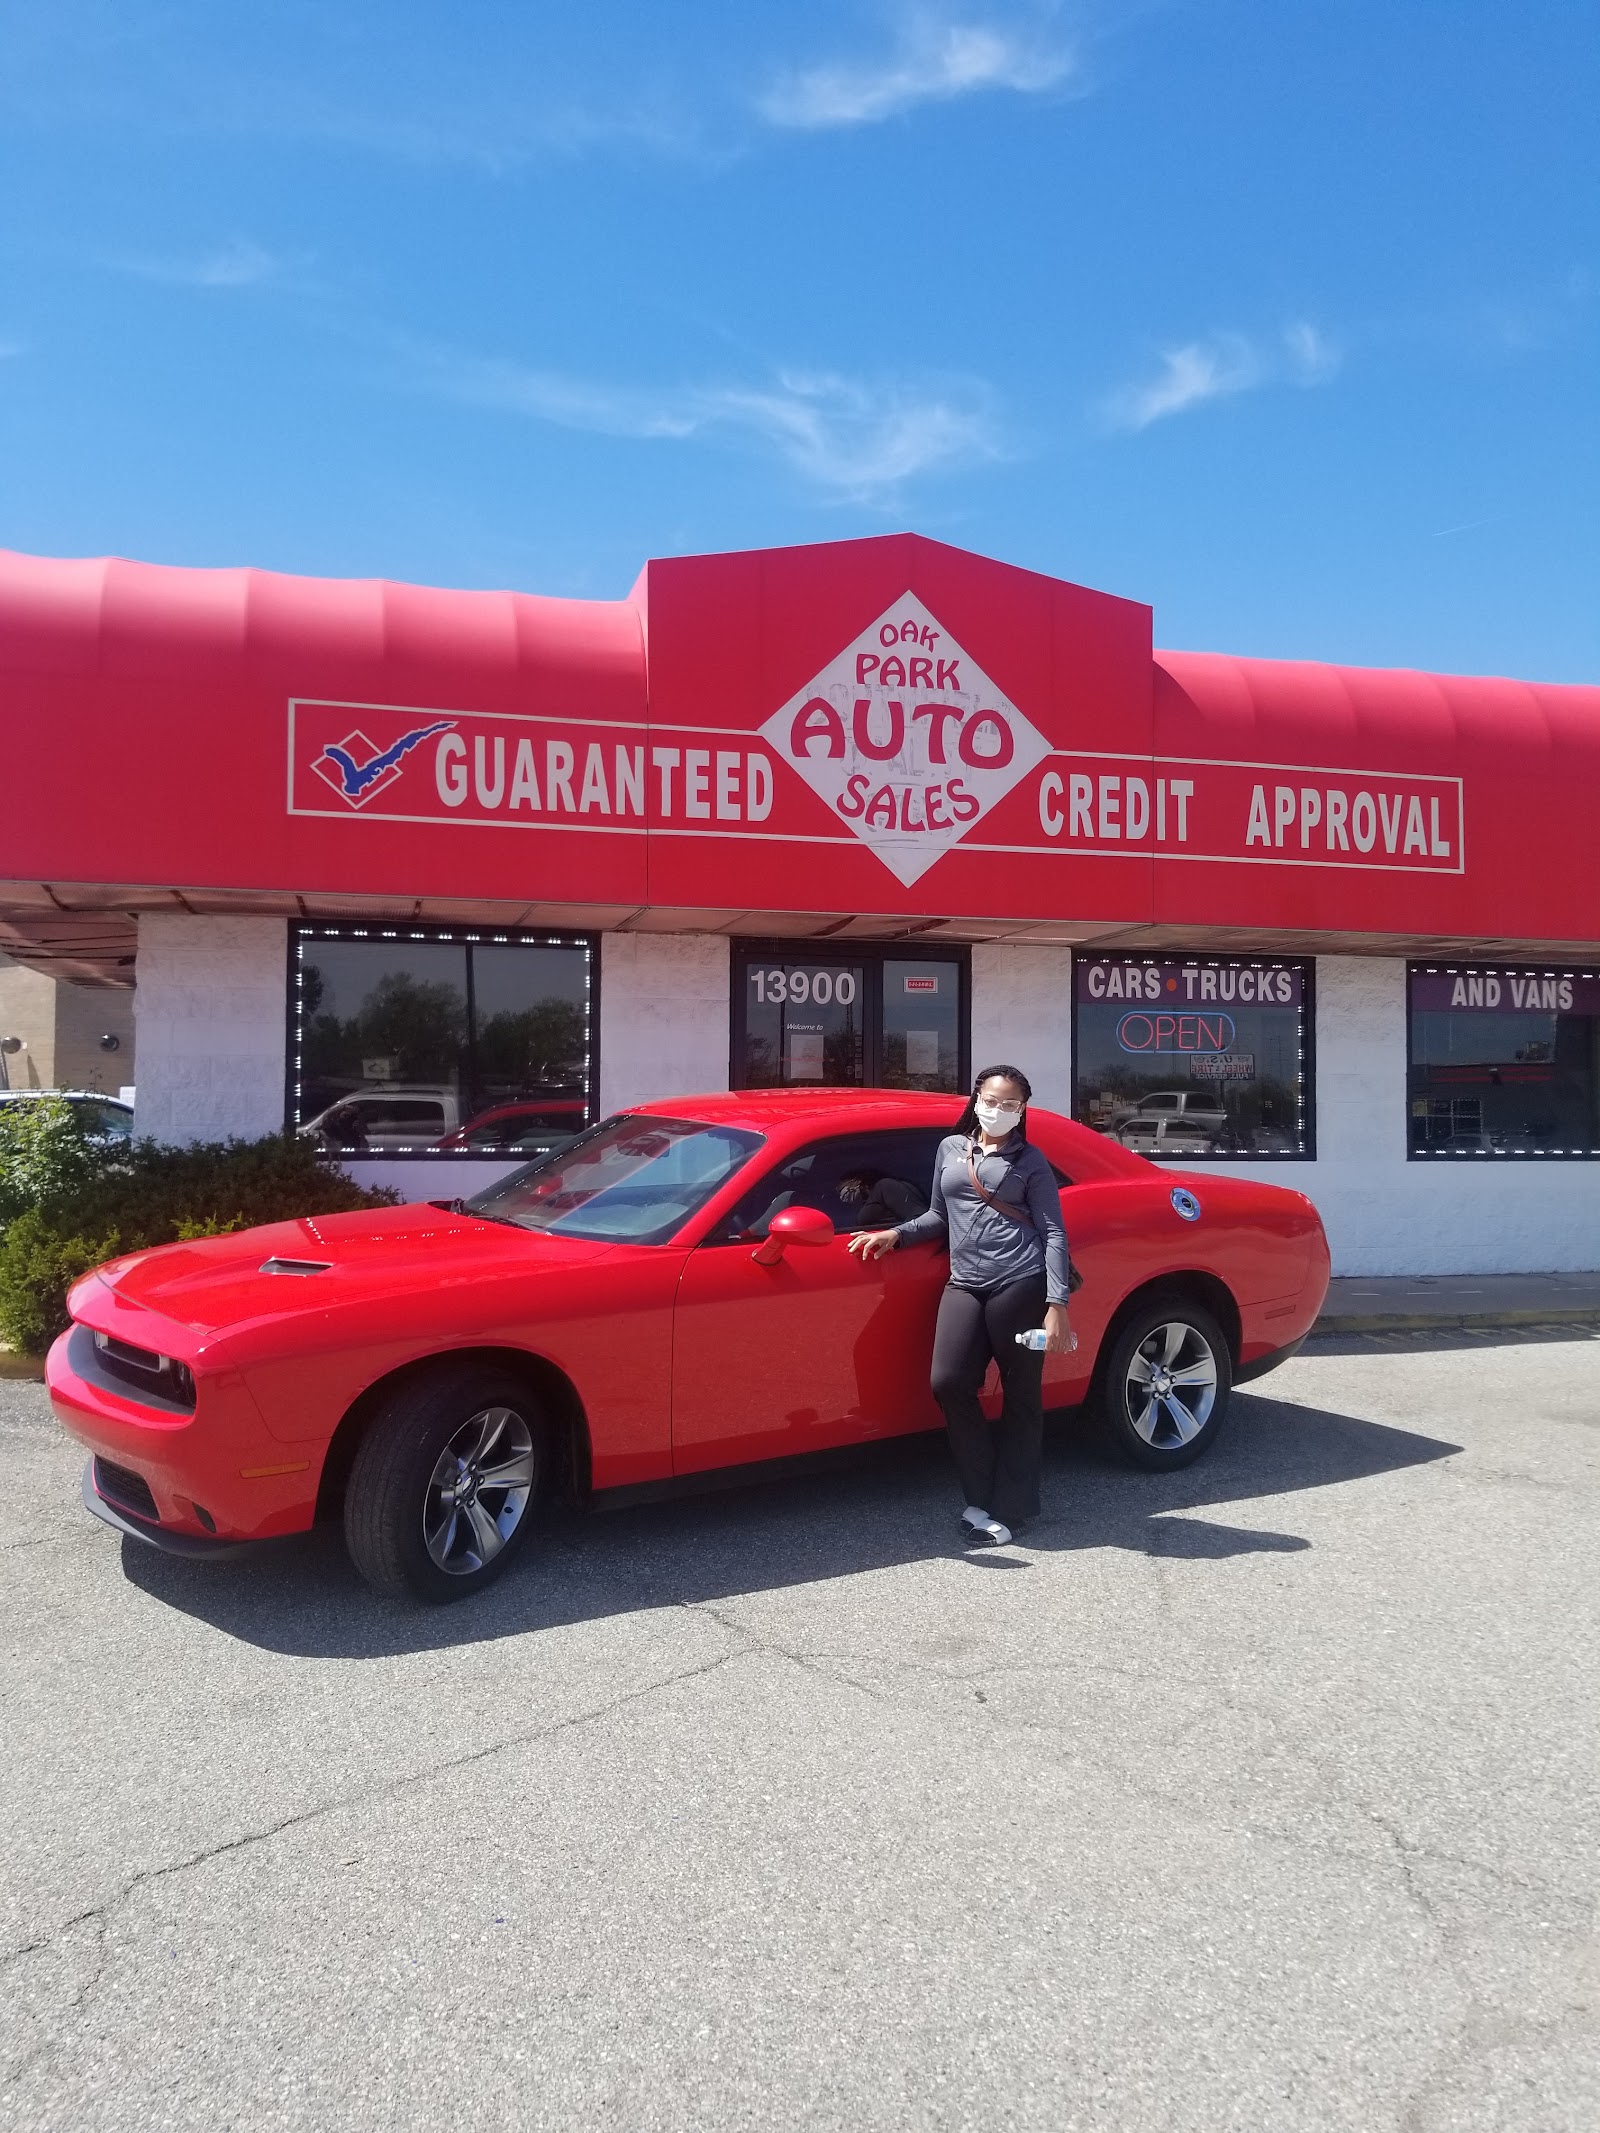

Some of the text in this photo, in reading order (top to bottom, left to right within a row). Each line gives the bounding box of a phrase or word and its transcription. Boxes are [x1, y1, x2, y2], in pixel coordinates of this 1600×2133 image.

[879, 619, 940, 653] OAK
[855, 653, 961, 691] PARK
[790, 696, 1015, 770] AUTO
[434, 731, 775, 823] GUARANTEED
[836, 774, 981, 832] SALES
[1038, 770, 1451, 858] CREDIT APPROVAL
[750, 970, 857, 1005] 13900
[1087, 965, 1293, 1003] CARS TRUCKS
[1450, 976, 1574, 1011] AND VANS
[786, 1023, 816, 1031] Welcome
[1121, 1015, 1223, 1050] OPEN
